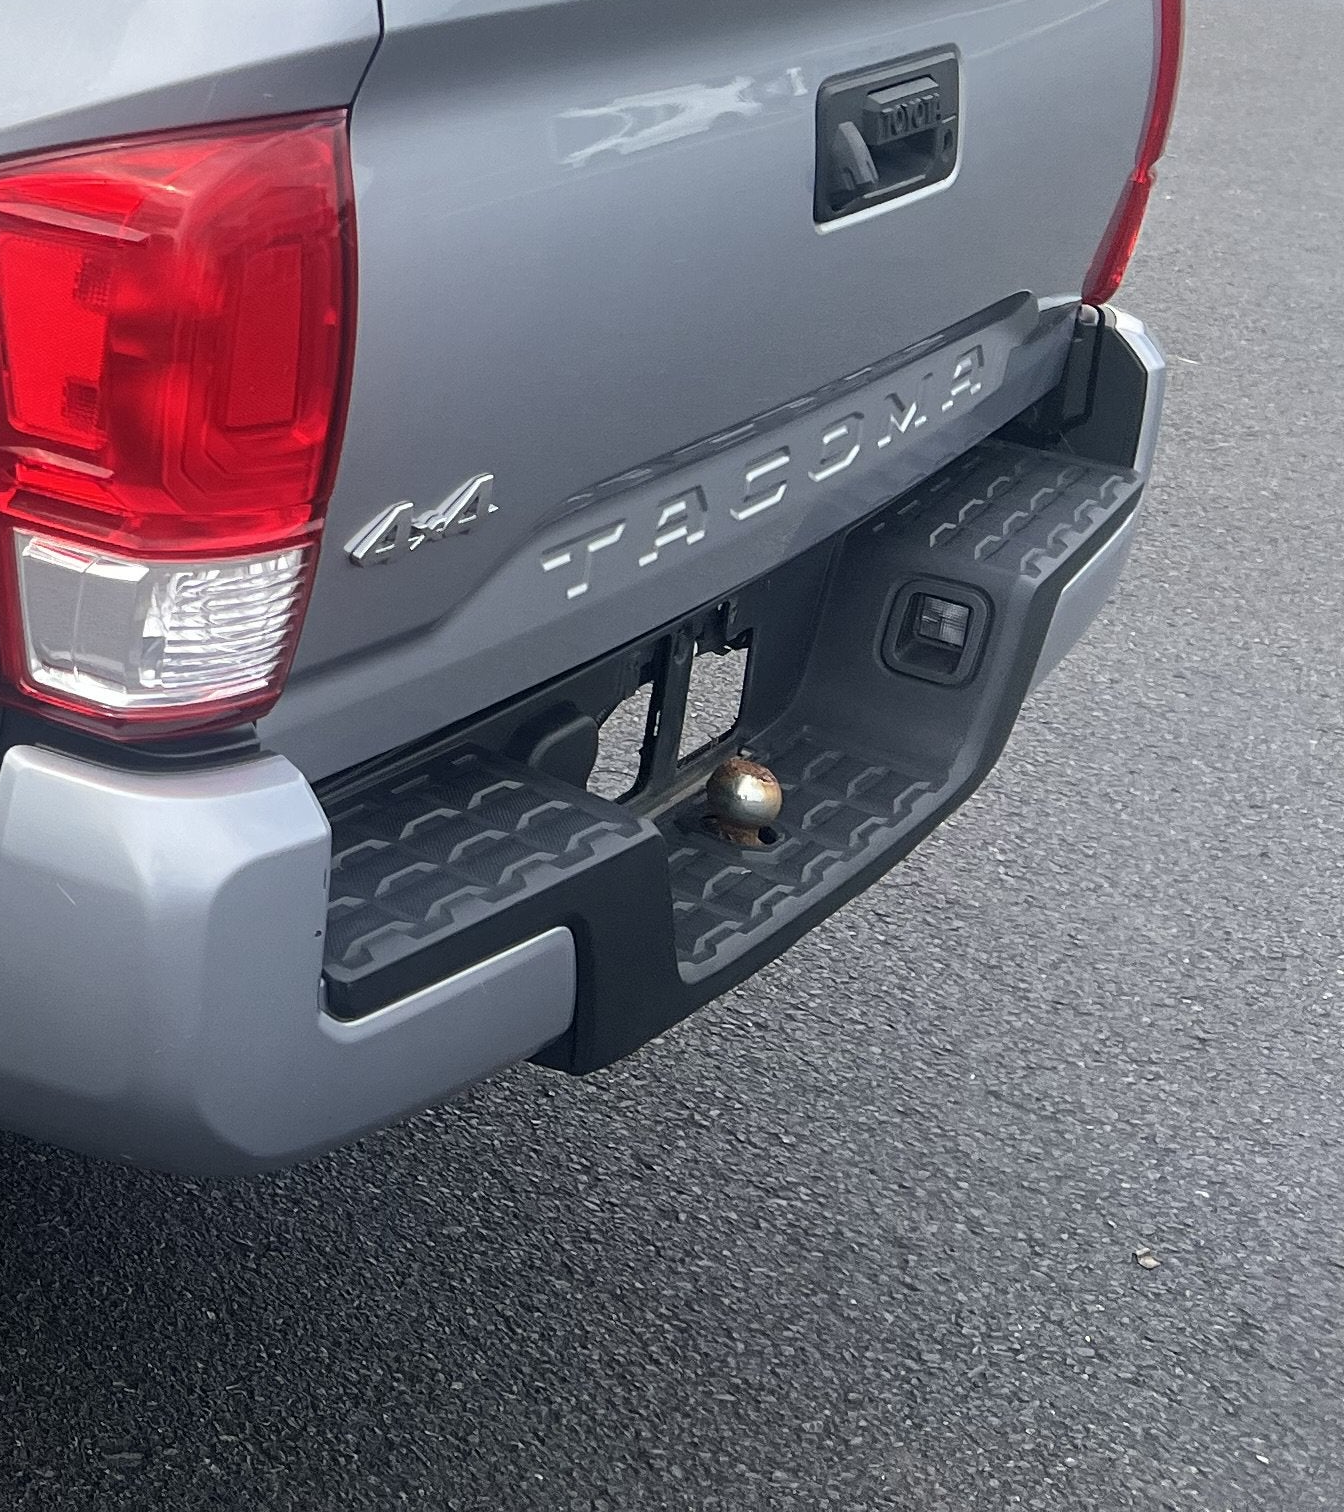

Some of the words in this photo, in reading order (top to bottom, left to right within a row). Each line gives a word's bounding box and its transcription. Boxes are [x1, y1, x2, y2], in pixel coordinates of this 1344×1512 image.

[878, 92, 941, 140] TOYOTA
[344, 472, 500, 568] 4x4
[541, 344, 985, 600] TACOMA
